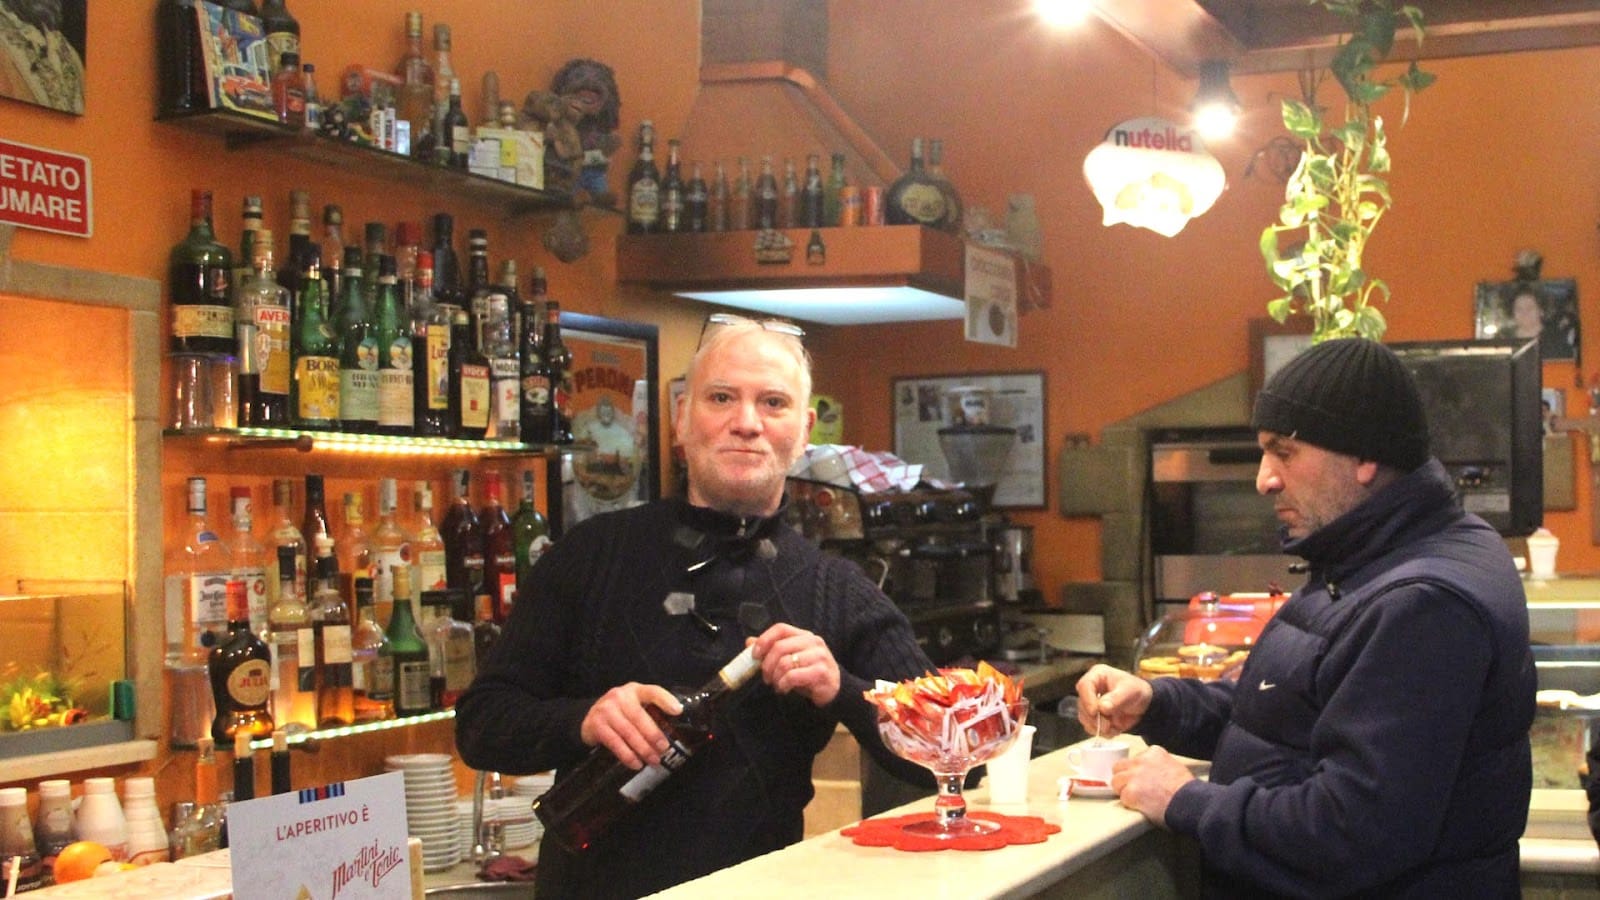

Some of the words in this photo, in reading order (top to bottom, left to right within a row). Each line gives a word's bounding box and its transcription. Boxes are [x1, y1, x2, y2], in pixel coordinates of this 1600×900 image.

[1115, 127, 1192, 151] nutella
[276, 809, 357, 841] L'APERITIVO
[331, 838, 379, 900] Martini
[369, 846, 404, 888] Tonic
